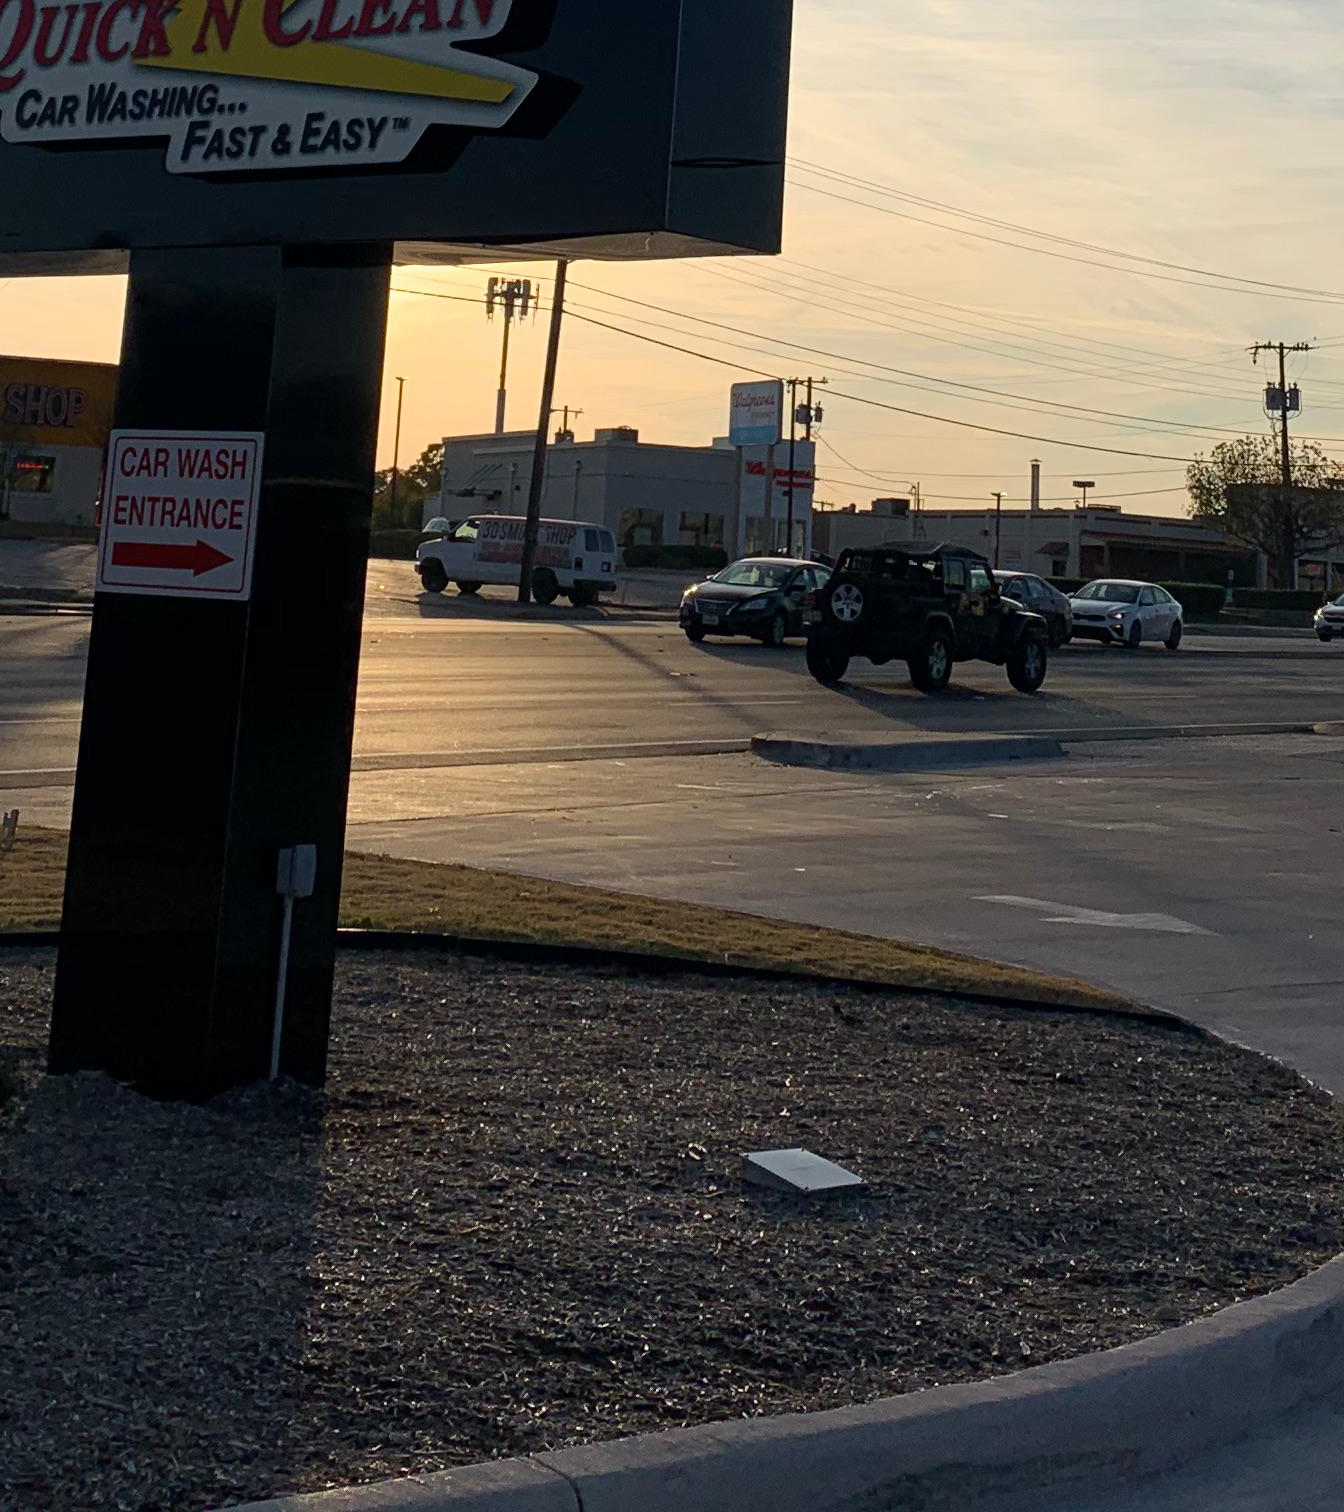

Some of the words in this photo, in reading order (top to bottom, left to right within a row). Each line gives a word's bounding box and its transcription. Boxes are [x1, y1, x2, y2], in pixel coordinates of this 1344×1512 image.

[14, 88, 77, 128] CAR
[178, 119, 265, 163] FAST
[270, 127, 293, 154] &
[4, 384, 87, 428] SHOP
[120, 446, 170, 478] CAR
[177, 448, 248, 480] WASH
[113, 495, 245, 530] ENTRANCE
